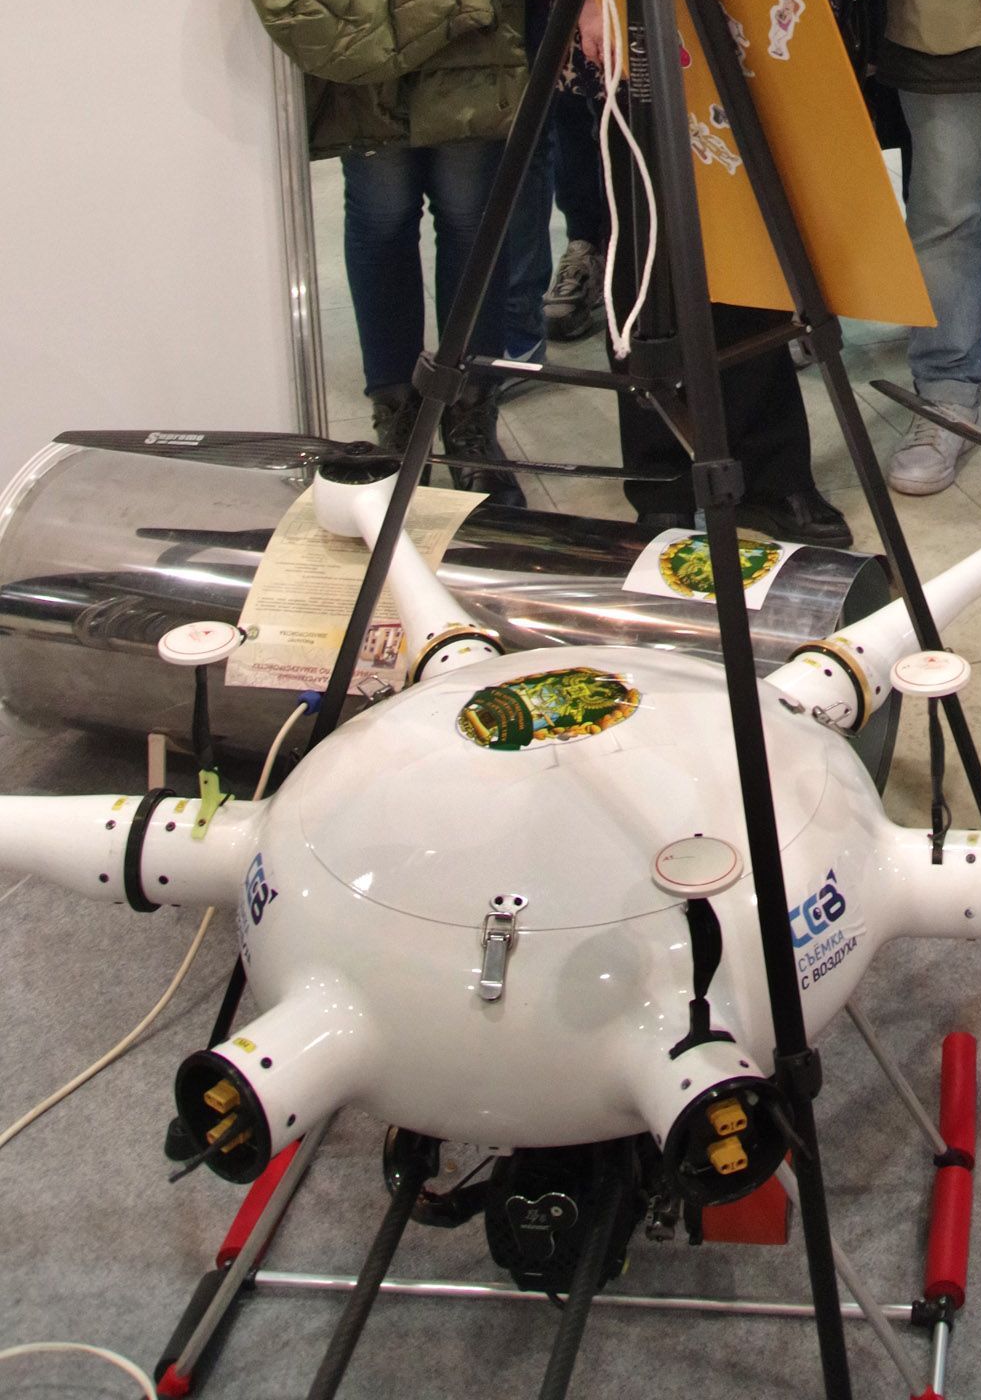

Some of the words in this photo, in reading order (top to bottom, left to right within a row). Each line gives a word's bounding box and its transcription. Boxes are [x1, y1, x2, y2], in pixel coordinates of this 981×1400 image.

[798, 929, 844, 973] СЪЁМКА
[801, 975, 811, 990] С
[812, 936, 858, 982] ВОЗДУХА
